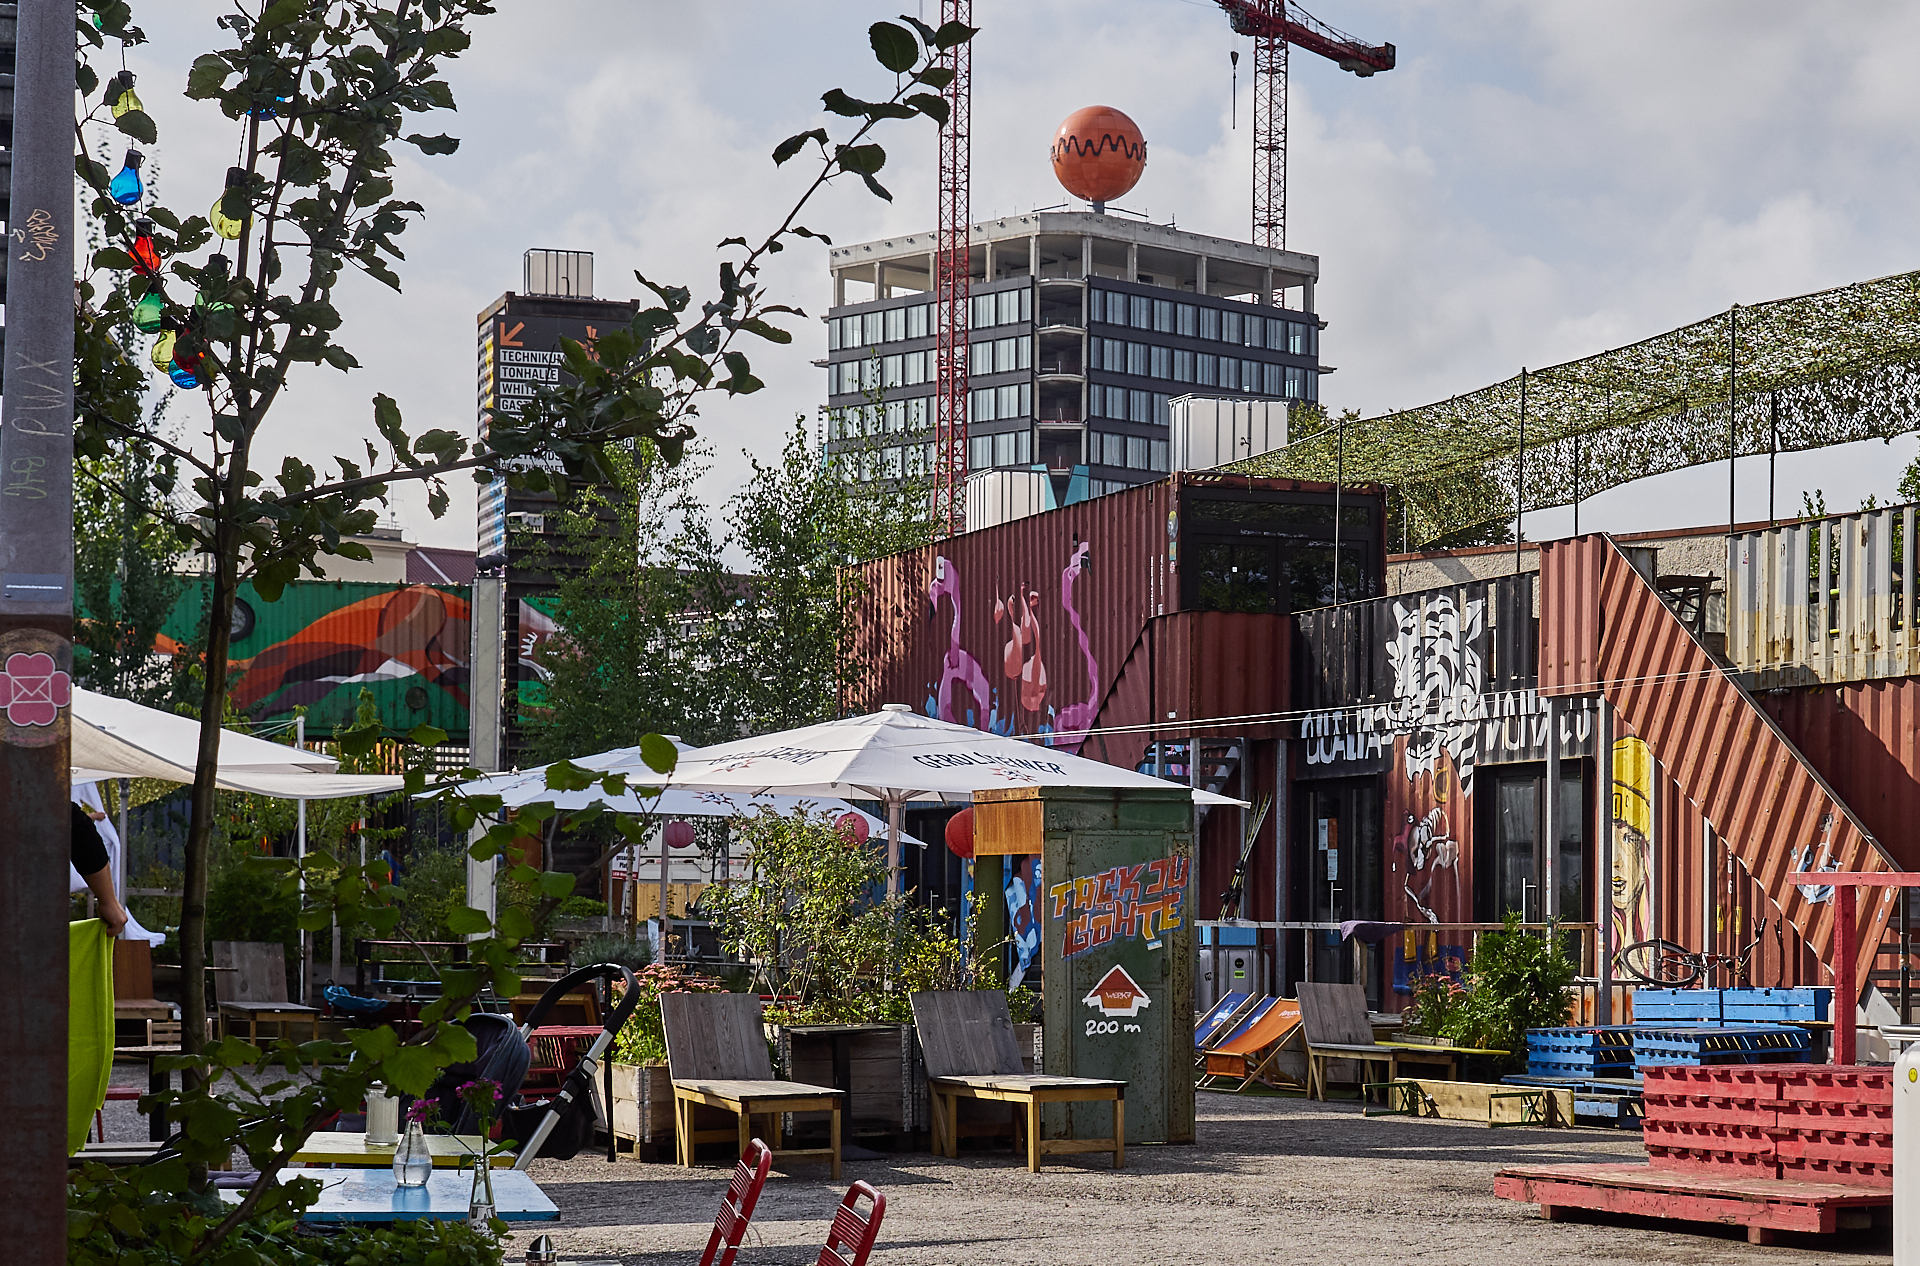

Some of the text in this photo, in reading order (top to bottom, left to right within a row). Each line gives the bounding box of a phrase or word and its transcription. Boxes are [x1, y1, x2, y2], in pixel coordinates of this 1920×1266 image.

[502, 351, 566, 365] TECHNIKUM
[502, 367, 557, 380] TONHALLE
[912, 751, 1068, 776] GEROLSTEINER
[1085, 1019, 1141, 1036] 200 m
